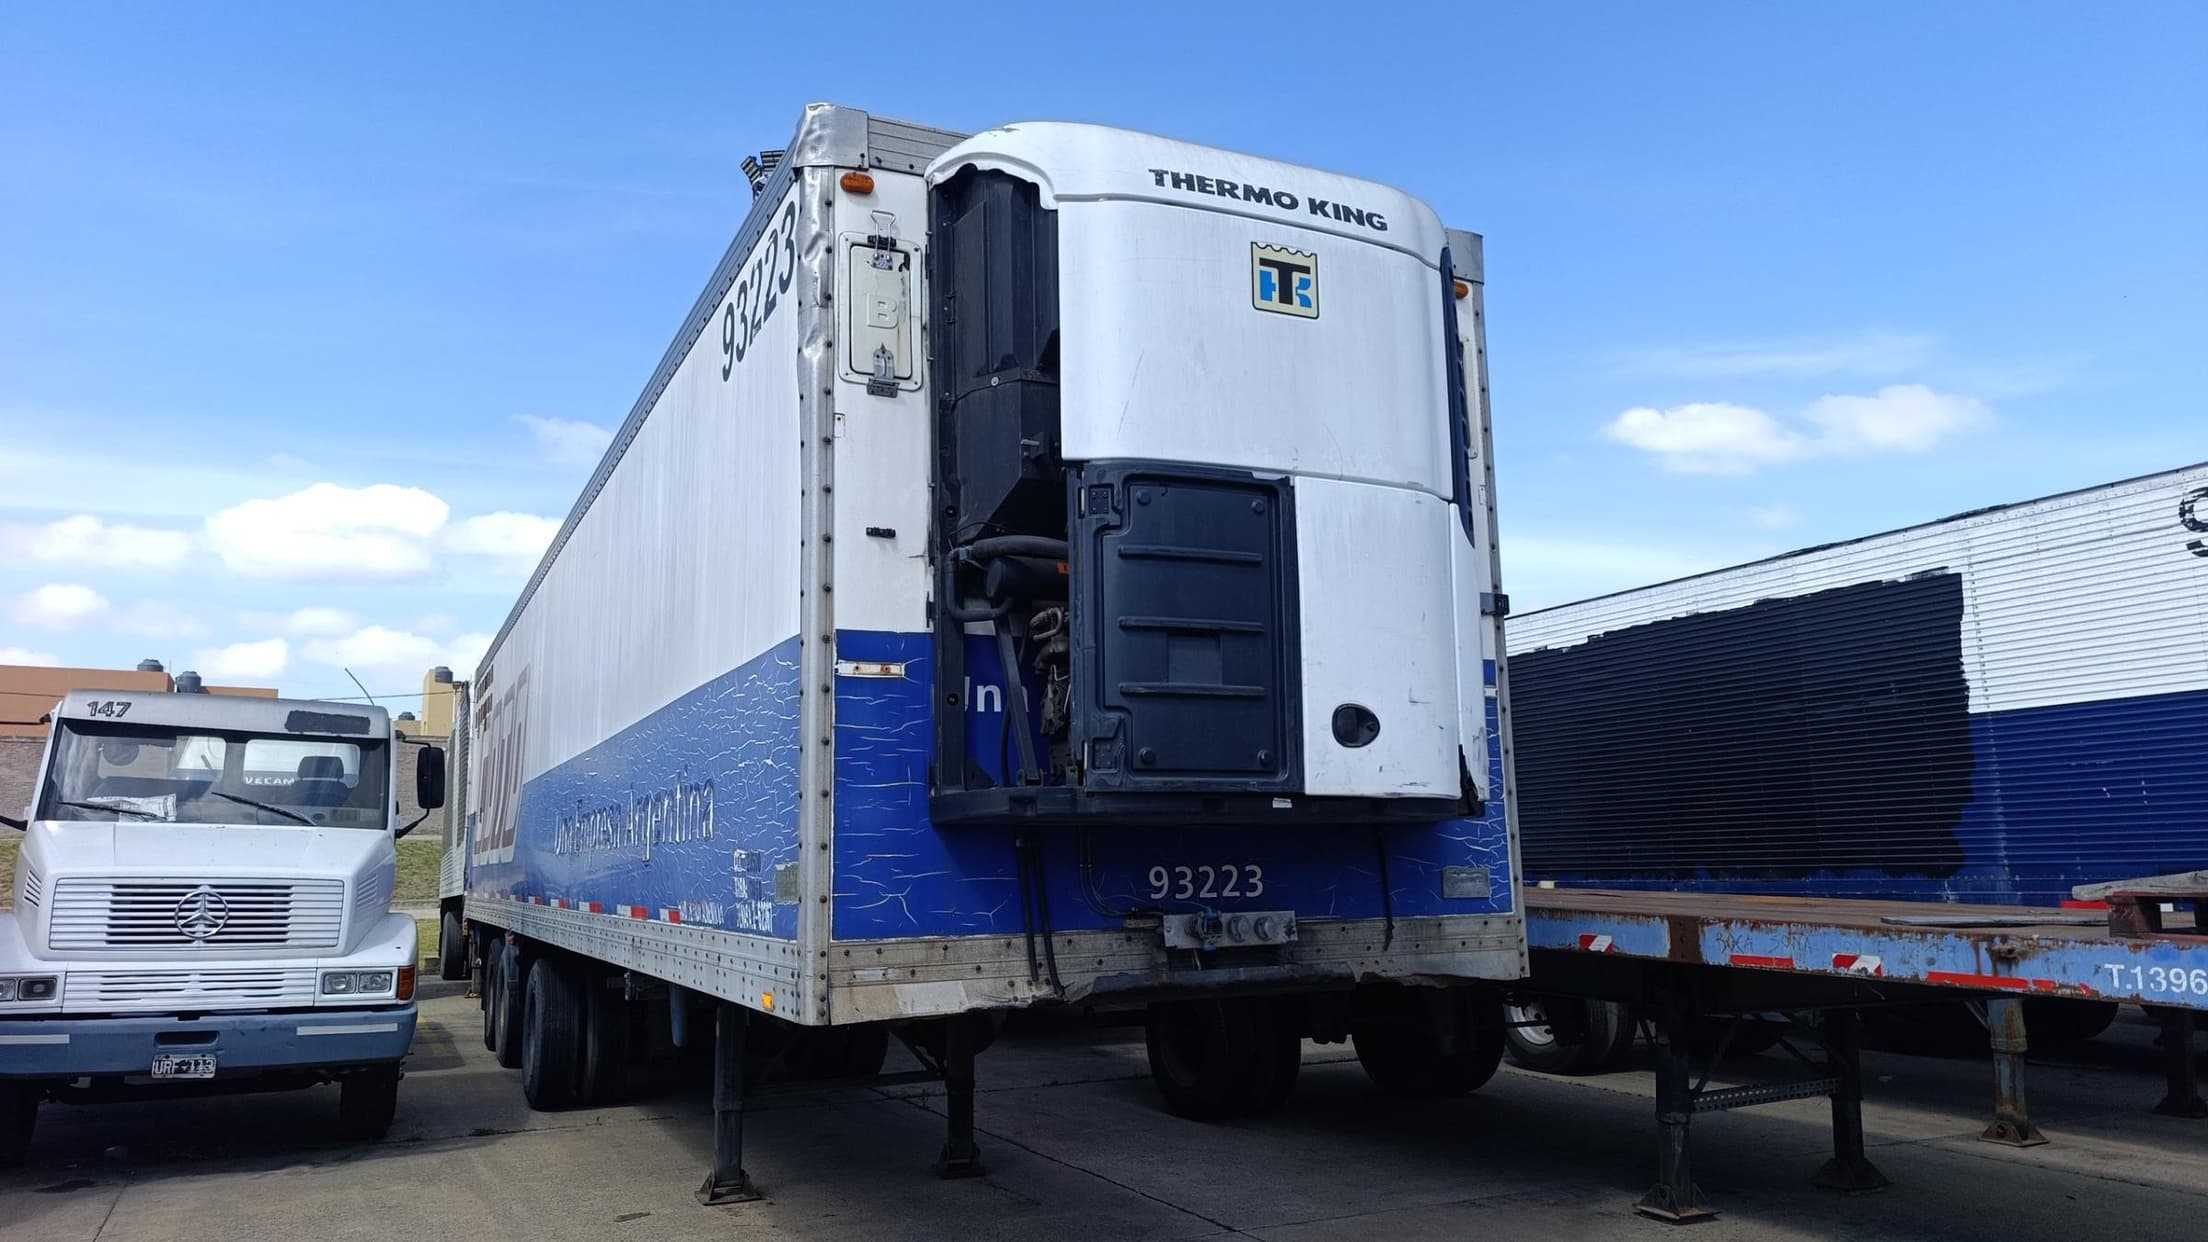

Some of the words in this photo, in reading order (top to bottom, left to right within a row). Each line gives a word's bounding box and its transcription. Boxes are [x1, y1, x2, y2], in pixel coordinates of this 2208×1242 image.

[1148, 168, 1299, 210] THERMO
[1308, 196, 1388, 232] KING
[722, 200, 797, 383] 93223
[87, 701, 132, 717] 147
[624, 764, 714, 867] Argentina
[1148, 864, 1265, 900] 93223
[2104, 963, 2208, 995] T.1396
